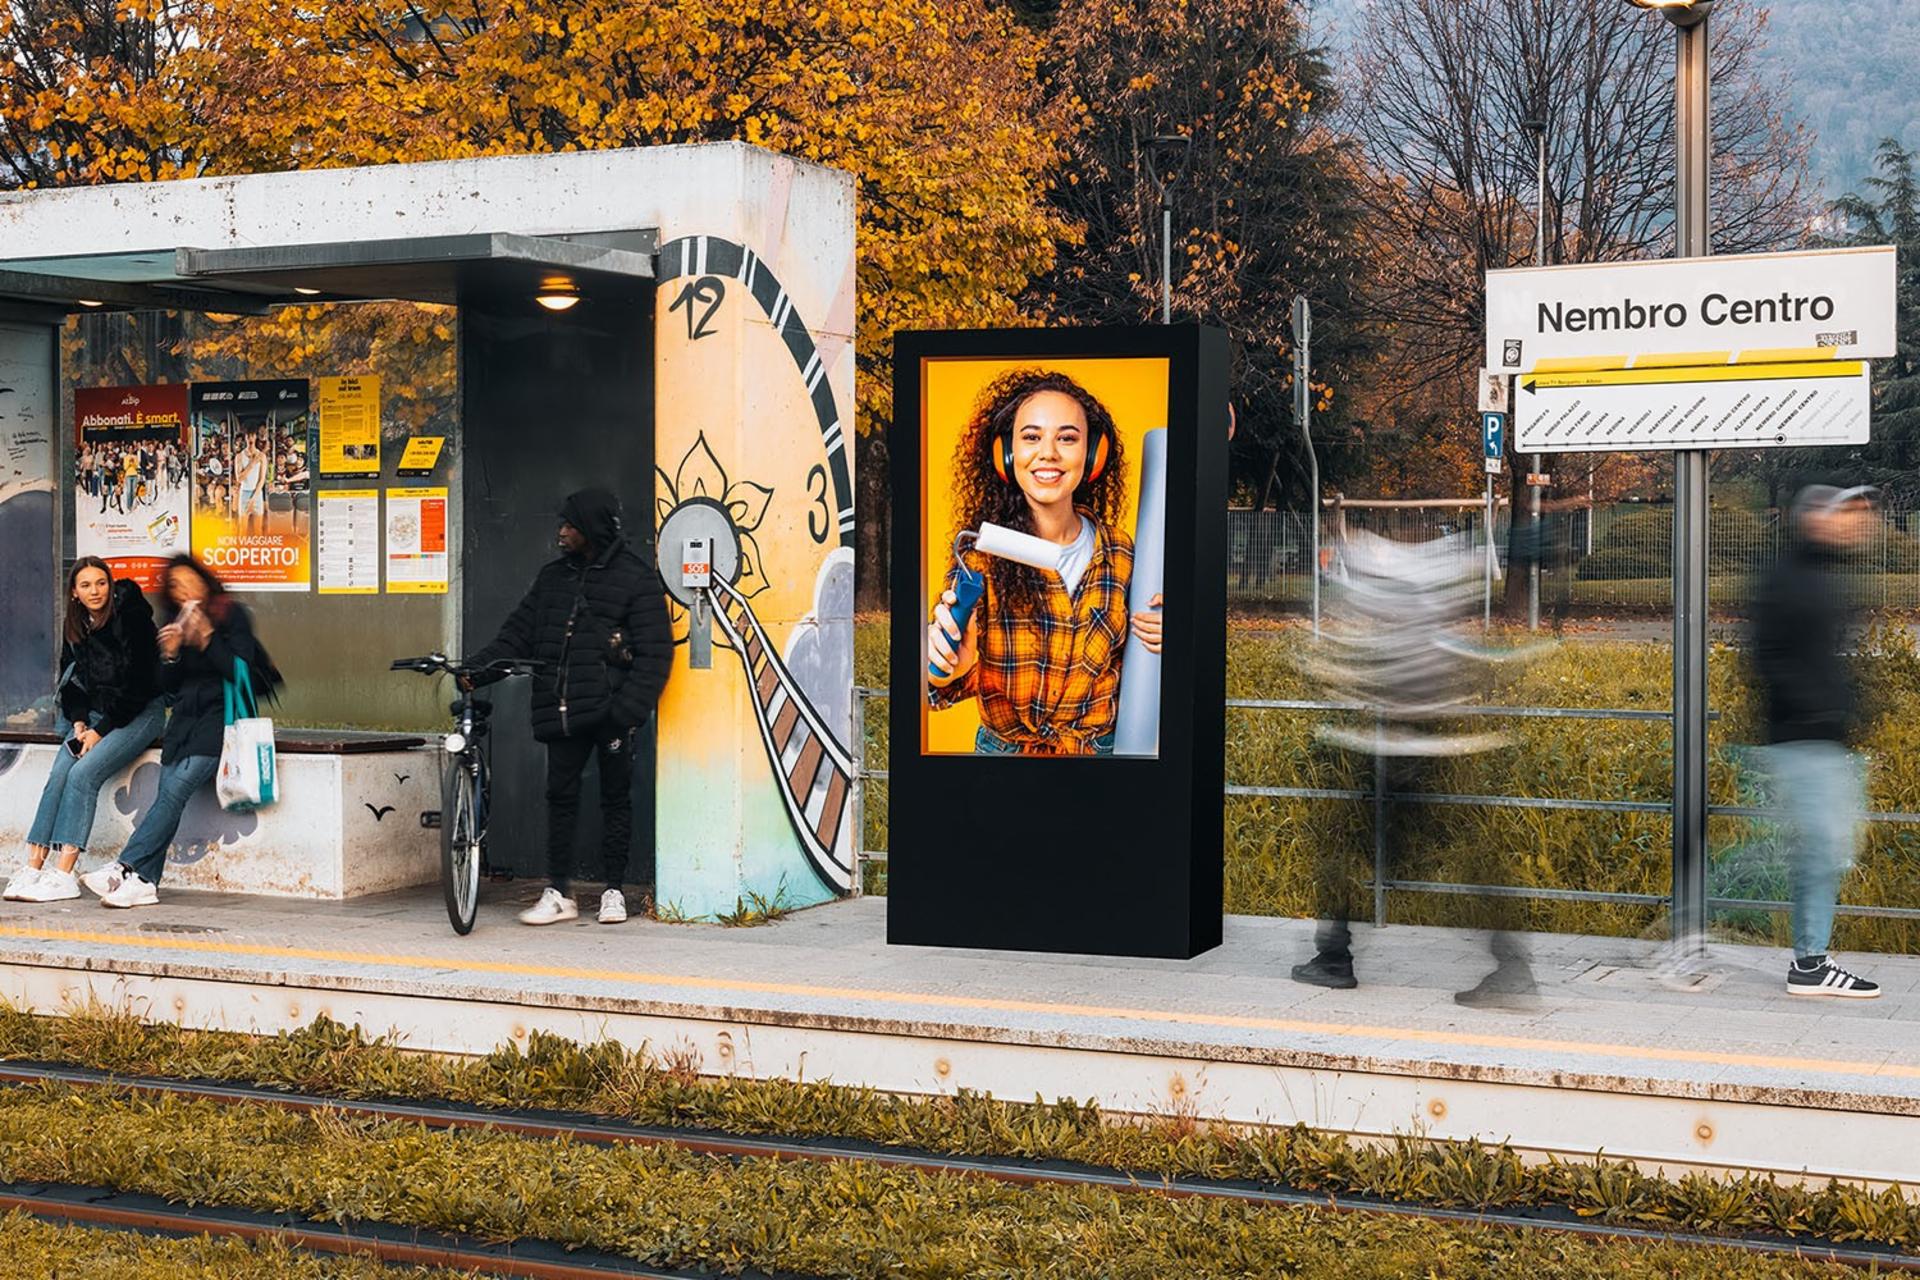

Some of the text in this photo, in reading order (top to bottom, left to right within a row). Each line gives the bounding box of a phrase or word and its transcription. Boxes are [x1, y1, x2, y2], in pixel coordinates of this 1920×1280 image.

[669, 276, 726, 340] 12
[1538, 292, 1834, 333] Nembro Centro
[82, 410, 180, 426] Abbonati. È smart.
[1712, 392, 1751, 433] ALZANO CENTRO
[1755, 410, 1777, 432] NEMBRO
[1777, 389, 1818, 431] NEMBRO CENTRO
[1487, 417, 1500, 440] P
[1734, 412, 1754, 432] ALZANO
[806, 463, 830, 545] 3
[217, 535, 284, 546] NON VIAGGIARE
[202, 547, 300, 566] SCOPERTO!
[688, 564, 704, 574] SOS
